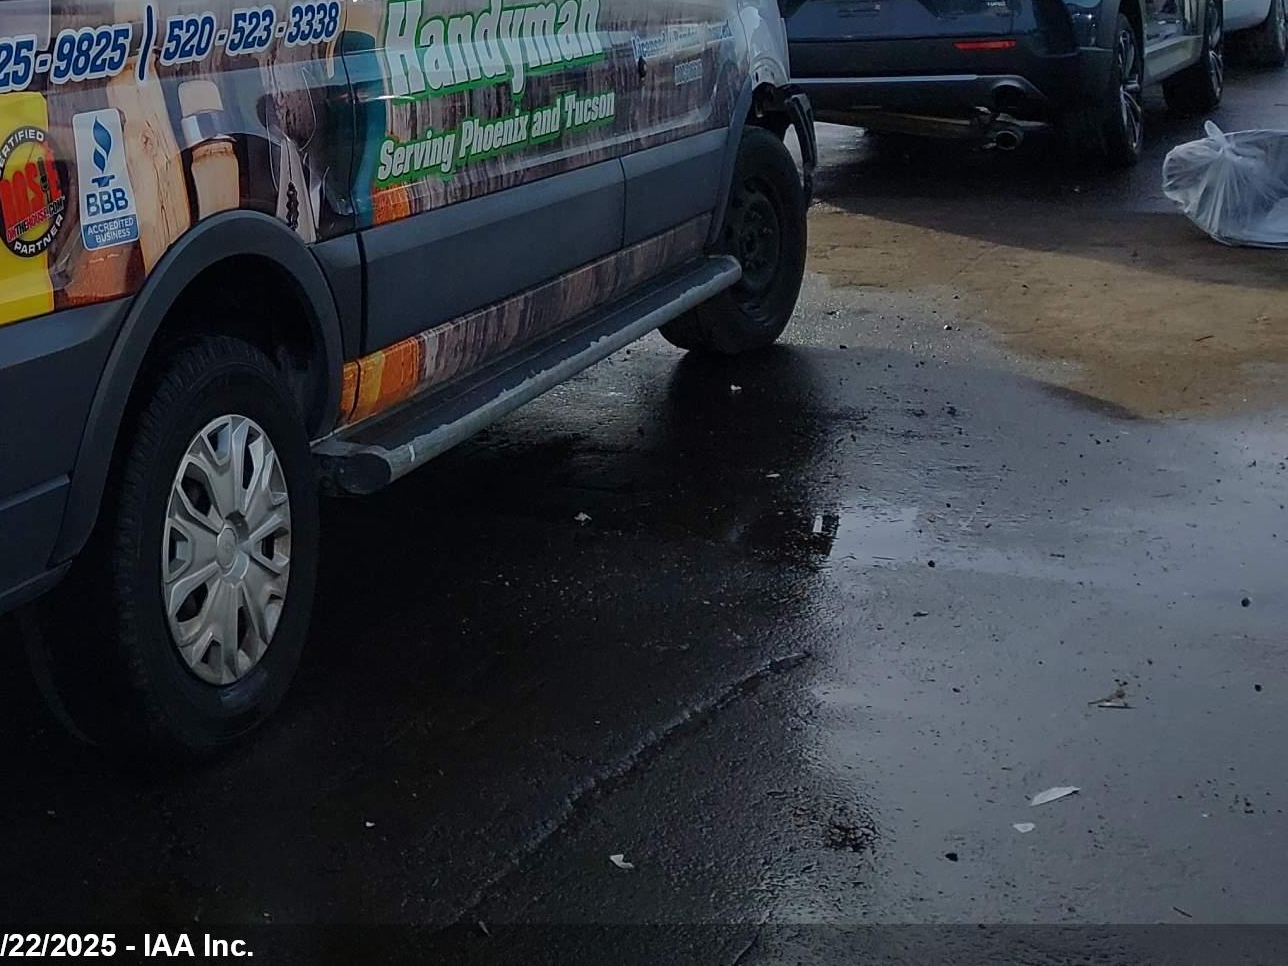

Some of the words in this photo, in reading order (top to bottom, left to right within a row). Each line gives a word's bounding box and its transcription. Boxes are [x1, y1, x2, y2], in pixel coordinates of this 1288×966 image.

[162, 0, 341, 65] 520-523-3338
[378, 130, 455, 180] Serving
[460, 109, 529, 158] Phoenix
[532, 98, 561, 137] and
[565, 92, 615, 128] Tucson
[86, 187, 129, 217] BBB
[14, 214, 64, 254] PARTNER
[86, 217, 134, 235] ACCREDITED
[95, 229, 130, 244] BUSINESS
